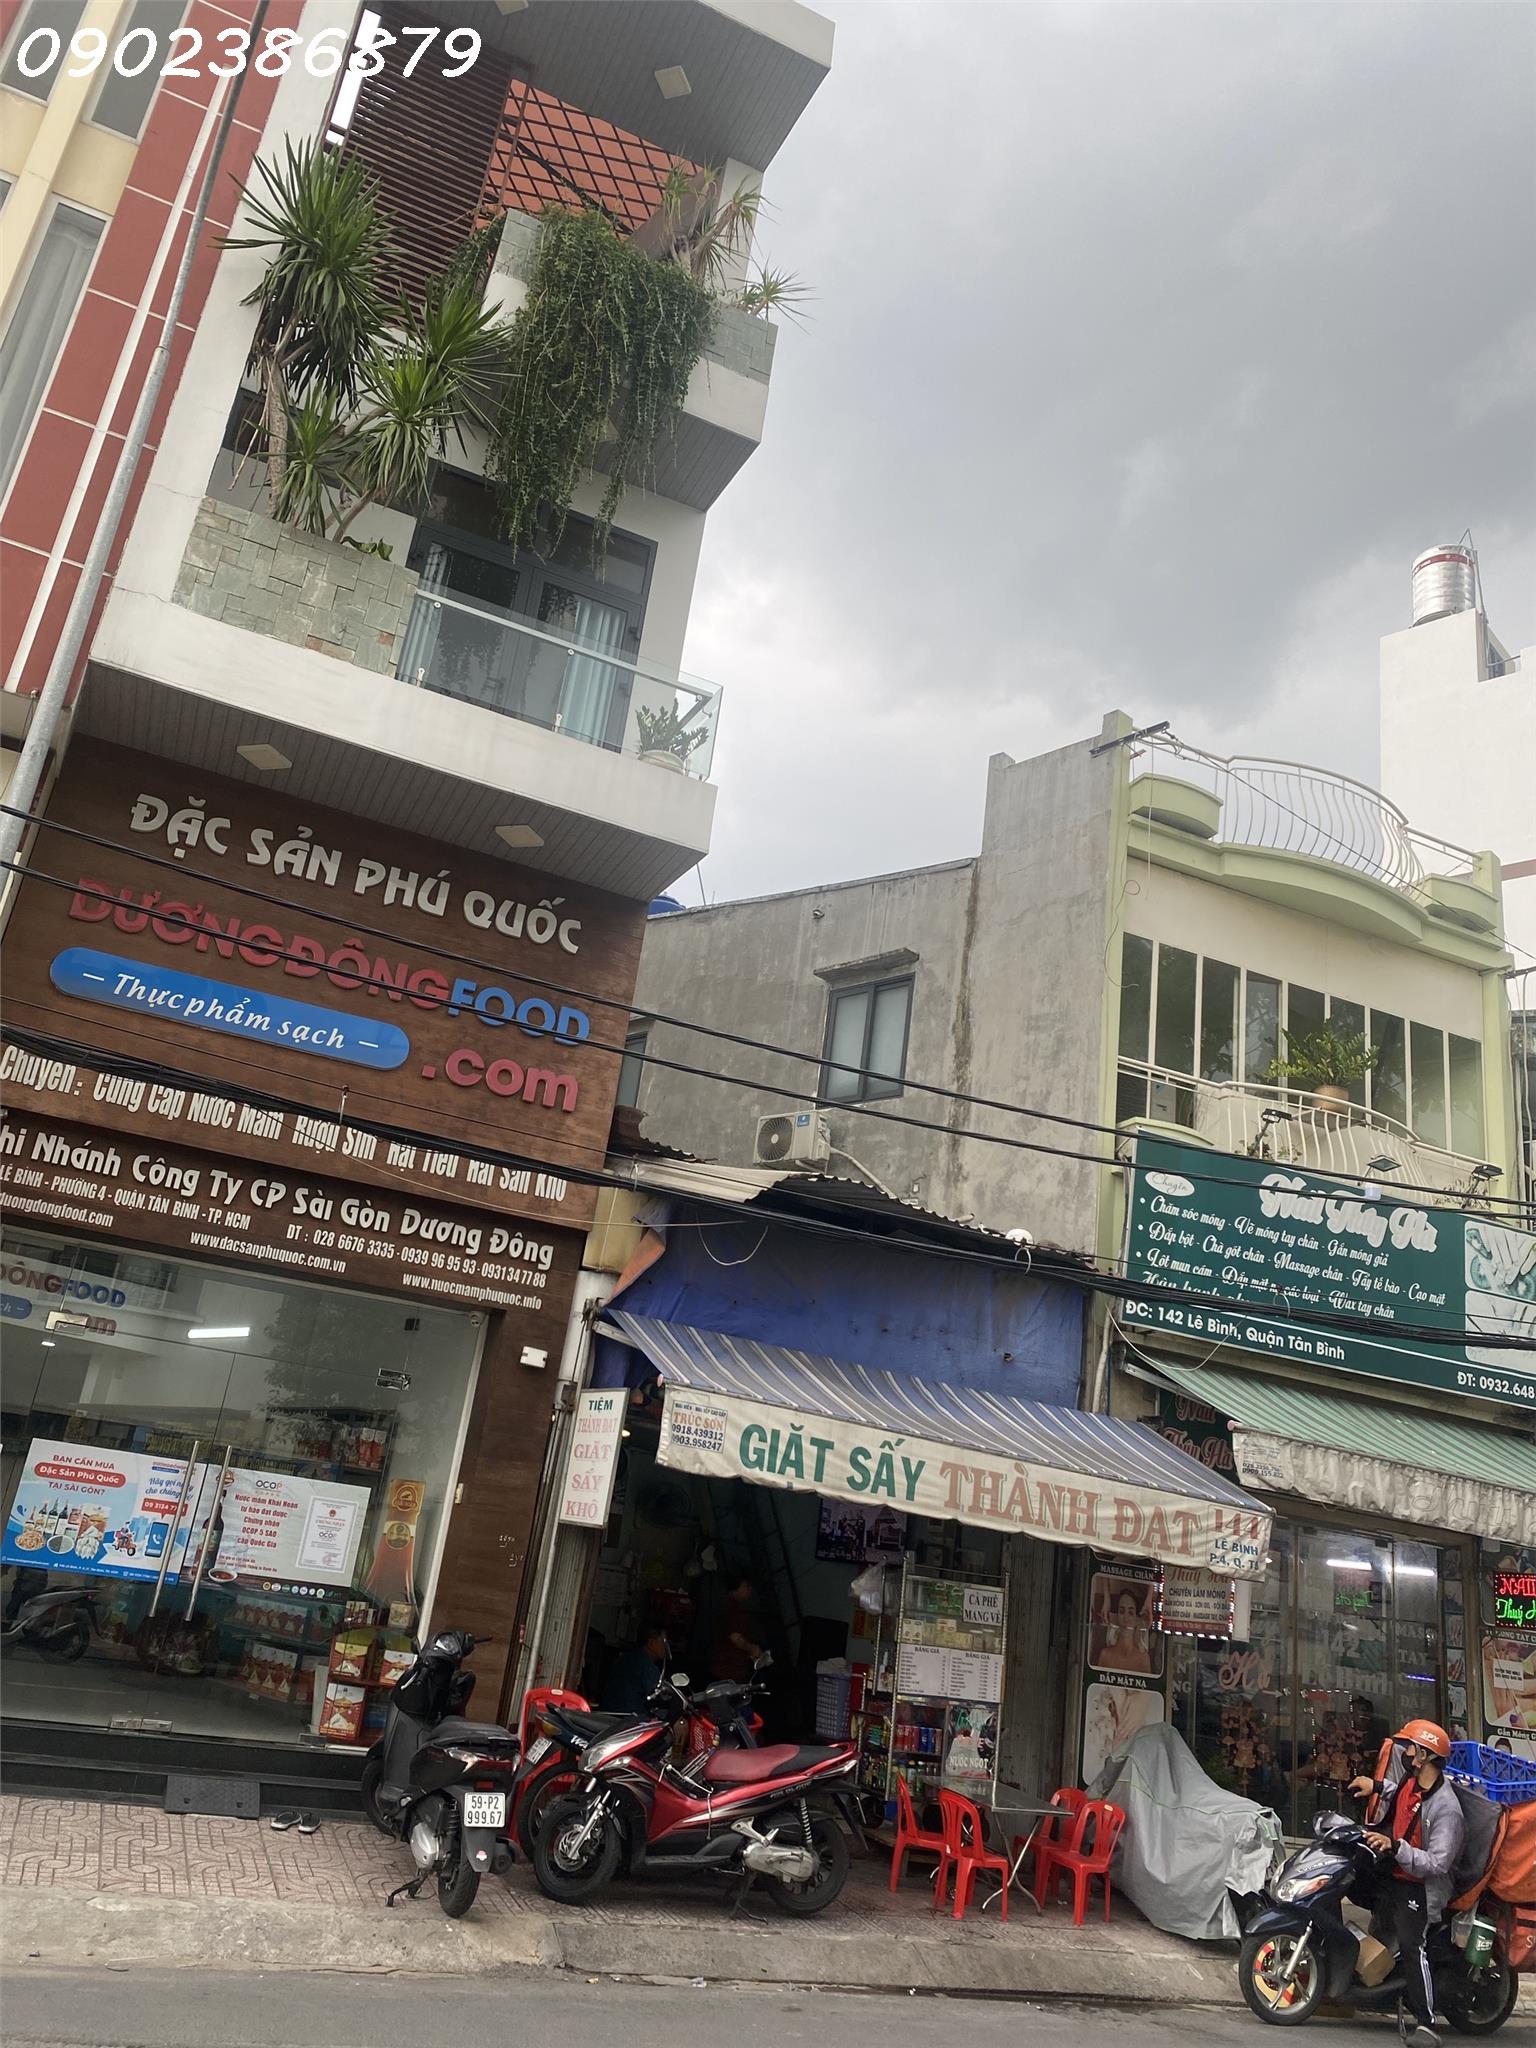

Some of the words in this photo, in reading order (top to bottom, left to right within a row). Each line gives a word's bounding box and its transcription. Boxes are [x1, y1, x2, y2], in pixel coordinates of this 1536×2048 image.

[130, 793, 231, 859] ĐẶC
[246, 826, 343, 887] SẢN
[353, 858, 451, 917] PHÚ
[463, 897, 582, 955] QUỐC
[113, 973, 184, 1009] Thực
[183, 997, 270, 1033] phẩm
[278, 1019, 345, 1050] sạch
[421, 1049, 579, 1113] .com
[13, 1166, 44, 1188] BÌNH
[50, 1176, 98, 1199] PHƯỜNG
[97, 1185, 107, 1201] 4
[172, 1199, 201, 1220] BÌNH
[224, 1211, 252, 1231] HCM
[31, 1132, 122, 1177] Nhánh
[132, 1155, 201, 1197] Công
[209, 1170, 243, 1205] Ty
[250, 1179, 287, 1209] CP
[292, 1187, 334, 1221] Sài
[340, 1198, 391, 1233] Gòn
[400, 1208, 483, 1256] Dương
[489, 1228, 554, 1271] Đông
[190, 1231, 347, 1273] www.dacsanphuquoc.com.vn
[313, 1229, 336, 1247] 028
[337, 1234, 366, 1253] 6676
[366, 1239, 395, 1259] 3335
[400, 1246, 429, 1265] 0939
[430, 1252, 446, 1269] 96
[446, 1255, 461, 1272] 95
[462, 1258, 477, 1275] 93
[1150, 1195, 1180, 1217] Chăm
[1181, 1208, 1199, 1221] sóc
[1200, 1213, 1226, 1231] móng
[1255, 1225, 1280, 1244] móng
[1281, 1230, 1296, 1248] tay
[1297, 1234, 1319, 1251] chân
[1327, 1239, 1348, 1257] Gắn
[1349, 1248, 1373, 1266] móng
[1178, 1230, 1195, 1248] bột
[1202, 1234, 1225, 1254] Chà
[1225, 1246, 1242, 1260] gót
[1242, 1246, 1265, 1264] chân
[1273, 1251, 1321, 1278] Massage
[1322, 1265, 1344, 1282] chân
[1384, 1279, 1400, 1294] bào
[1408, 1283, 1428, 1302] Cạo
[1192, 1265, 1213, 1277] cám
[1357, 1301, 1373, 1317] tay
[1373, 1303, 1395, 1319] chân
[1125, 1300, 1153, 1319] ĐC:
[1157, 1306, 1184, 1326] 142
[1187, 1313, 1203, 1330] Lê
[1207, 1318, 1242, 1342] Bình,
[1246, 1327, 1285, 1349] Quận
[1287, 1335, 1313, 1353] Tân
[1316, 1341, 1345, 1361] Bình
[1457, 1371, 1476, 1387] ĐT:
[588, 1396, 613, 1412] TIỆM
[671, 1423, 724, 1442] 0918.439312
[58, 1467, 76, 1478] Sản
[76, 1471, 95, 1480] Phú
[571, 1468, 603, 1491] SẤY
[739, 1423, 835, 1489] GIẶT
[846, 1438, 926, 1502] SẤY
[939, 1461, 1101, 1537] THÀNH
[565, 1499, 598, 1519] KHÔ
[964, 1608, 988, 1624] MANG
[968, 1592, 980, 1606] CÀ
[981, 1593, 999, 1608] PHÊ
[1419, 1731, 1440, 1747] SPX
[467, 1810, 503, 1825] 999.67
